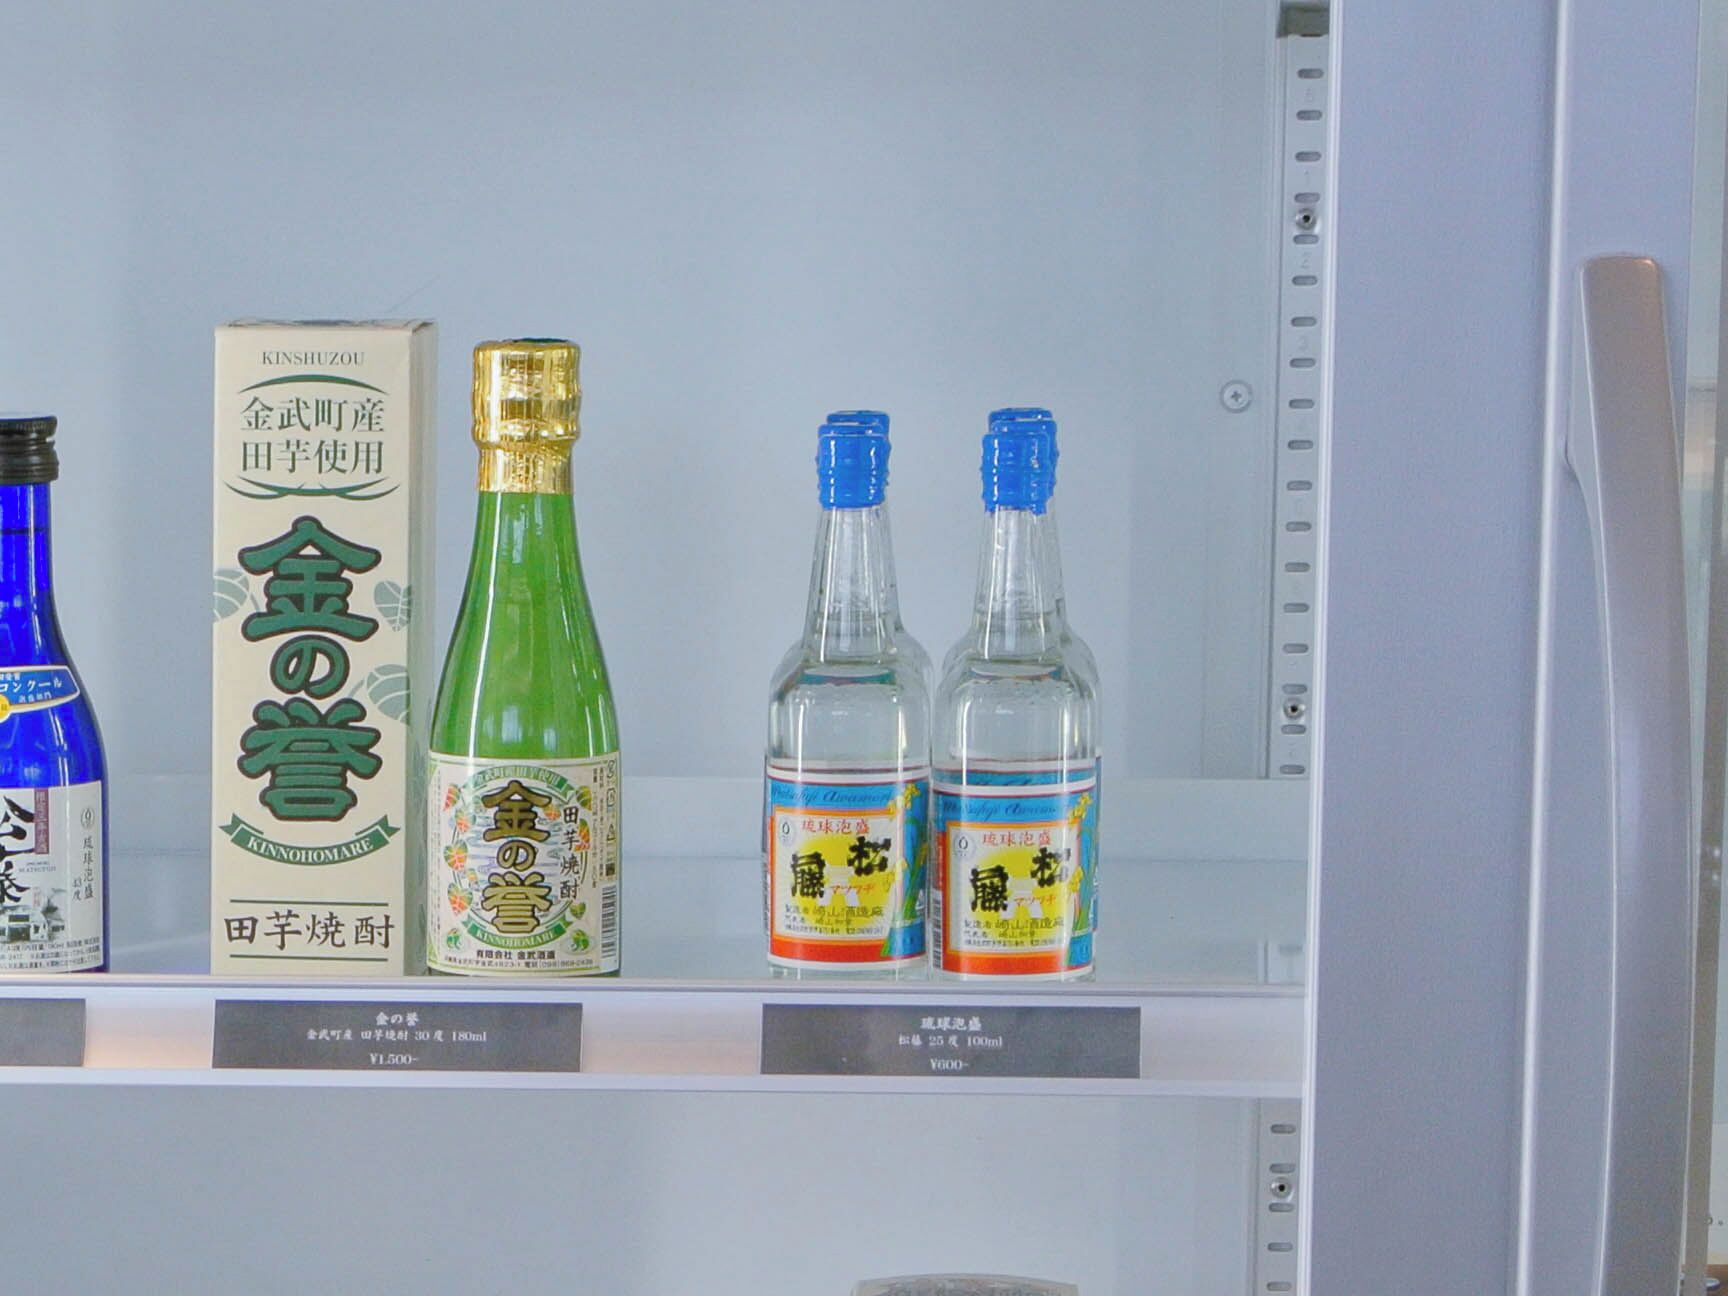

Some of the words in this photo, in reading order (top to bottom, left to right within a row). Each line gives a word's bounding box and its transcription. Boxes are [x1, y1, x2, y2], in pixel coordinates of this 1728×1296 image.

[262, 352, 365, 365] KINSHUZOU
[240, 396, 385, 432] 金武町産
[242, 439, 384, 474] 田芋使用
[237, 515, 382, 822] 金の誉
[802, 818, 869, 834] 琉球泡盛
[983, 831, 1050, 846] 琉球泡盛
[247, 836, 375, 864] KINNOHOMARE
[481, 779, 553, 934] 金の誉
[559, 805, 580, 900] 田芋焼酎
[223, 908, 395, 952] 田芋焼酎
[476, 926, 556, 949] KINNOHOMARE
[476, 950, 512, 960] 有限会社
[375, 1011, 420, 1027] 金の誉
[920, 1016, 982, 1032] 琉球泡盛
[451, 1031, 488, 1042] 180ml
[966, 1035, 1004, 1048] 100ml
